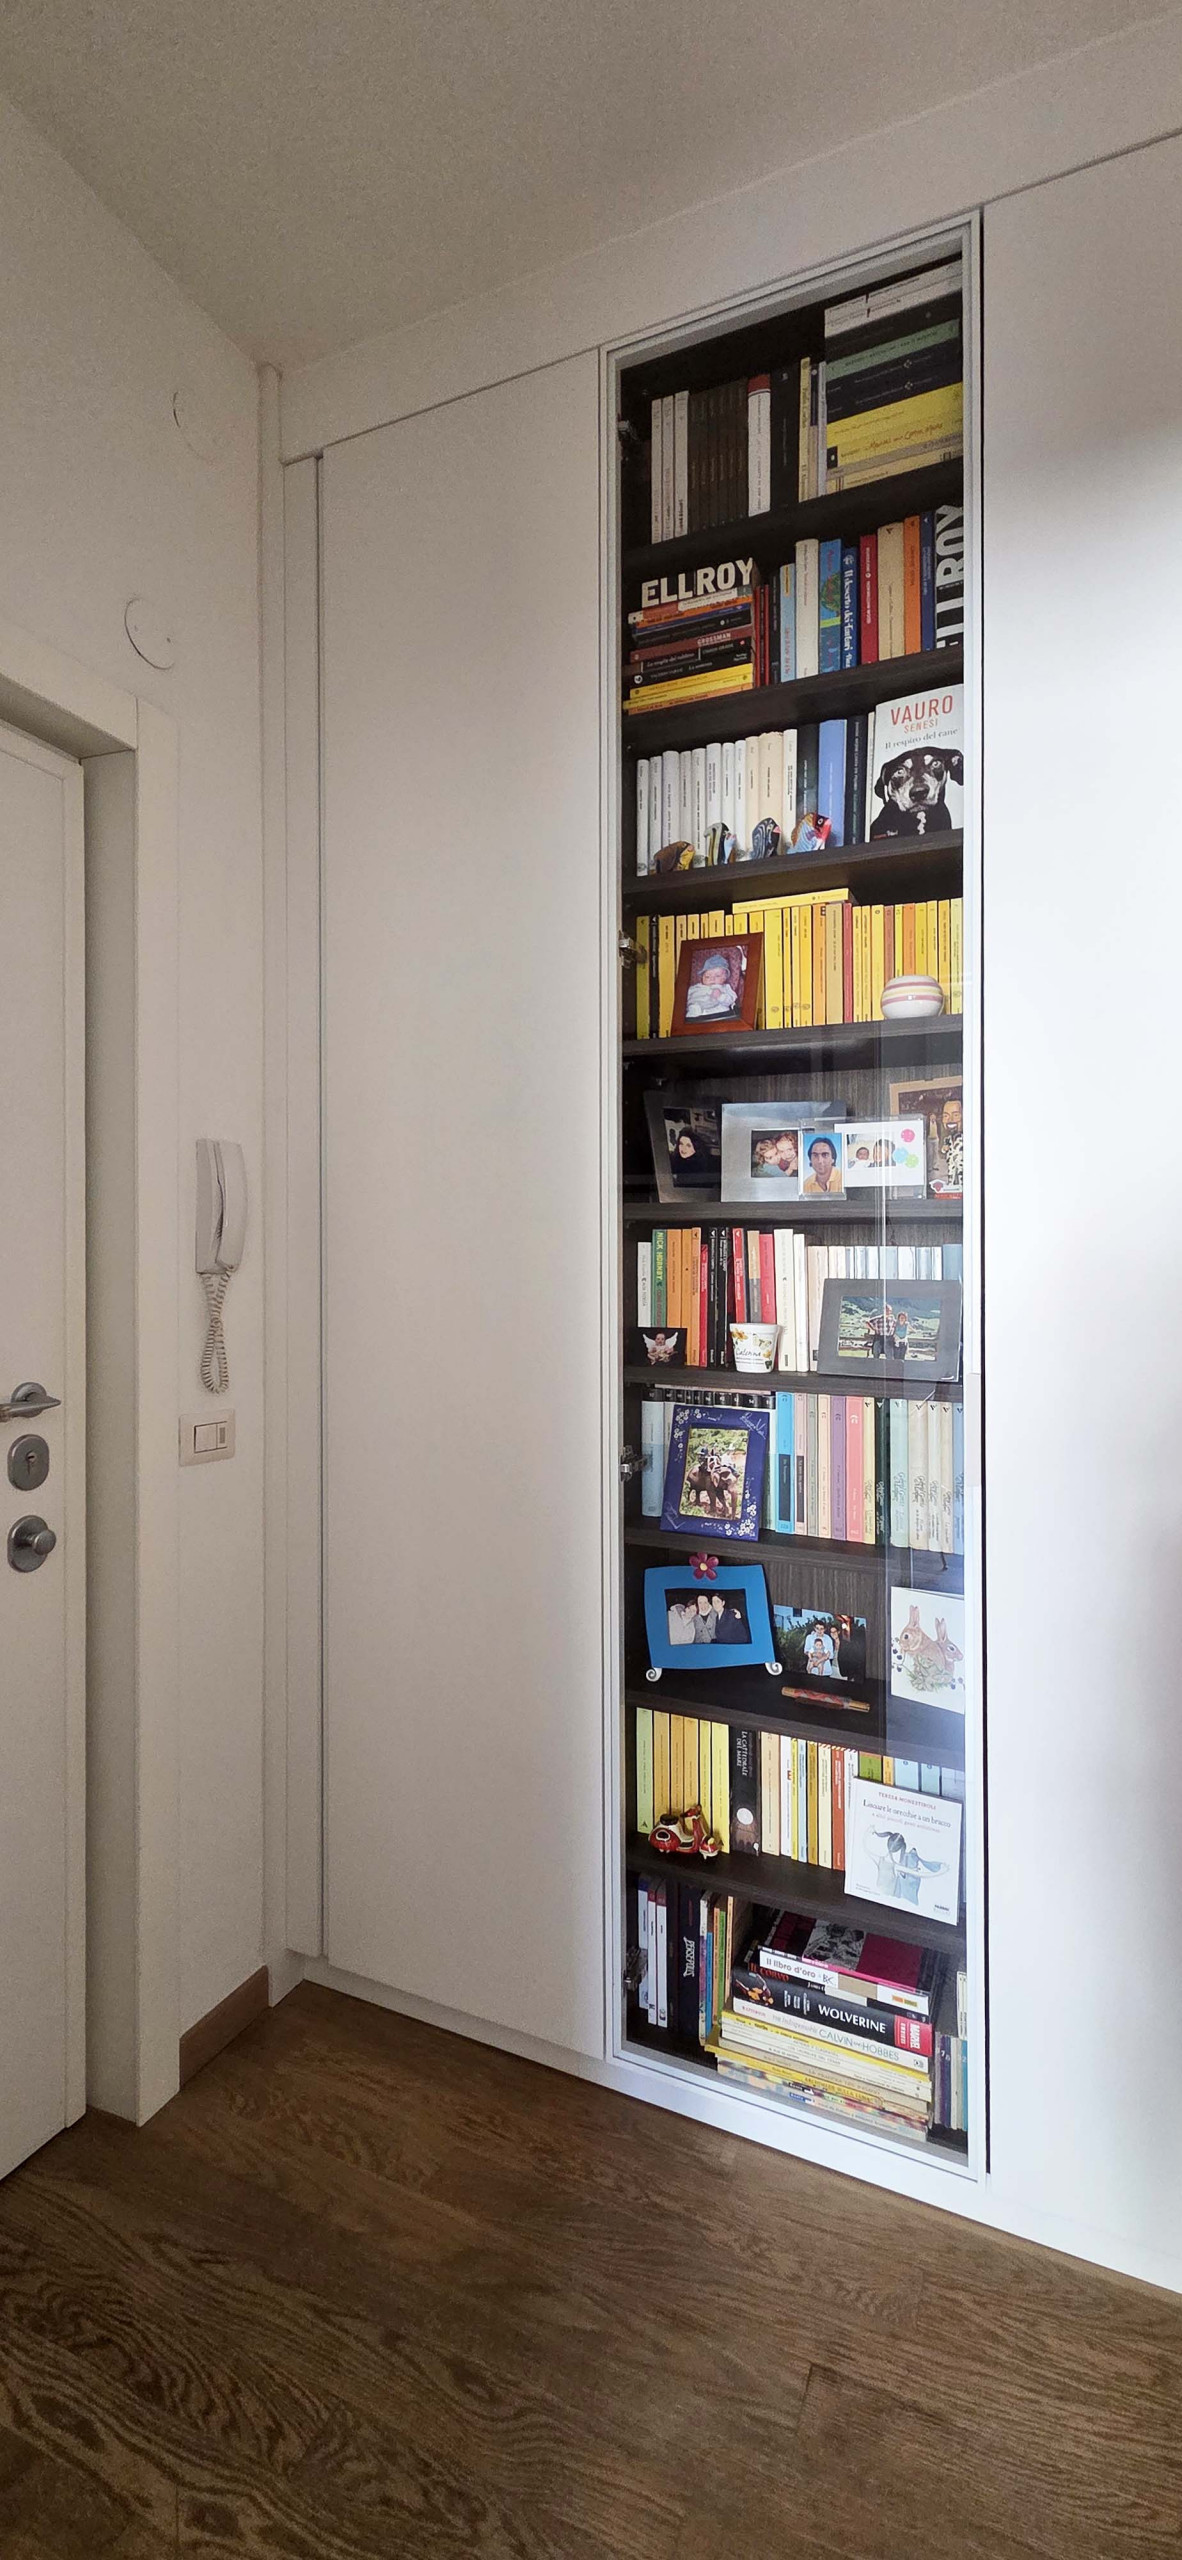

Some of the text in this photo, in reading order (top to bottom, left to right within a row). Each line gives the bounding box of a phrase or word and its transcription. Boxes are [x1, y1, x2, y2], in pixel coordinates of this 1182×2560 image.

[641, 557, 753, 608] ELLROY
[890, 695, 953, 726] VAURO
[893, 736, 921, 749] respiro
[923, 731, 936, 741] del
[938, 728, 958, 739] cane
[903, 718, 939, 734] SENESI
[656, 1231, 664, 1250] NICK
[656, 1252, 664, 1281] HORNBY
[886, 1805, 892, 1813] le
[931, 1816, 951, 1828] bracco
[683, 1936, 695, 1977] PERSEPOLIS
[766, 1957, 772, 1966] Il
[773, 1959, 792, 1972] libro
[794, 1965, 816, 1979] d'oro
[759, 1967, 789, 1982] CORVO
[818, 2004, 887, 2034] WOLVERINE
[819, 2028, 854, 2047] CALVIN
[862, 2042, 900, 2062] HOBBES
[910, 2023, 920, 2050] MARVEL
